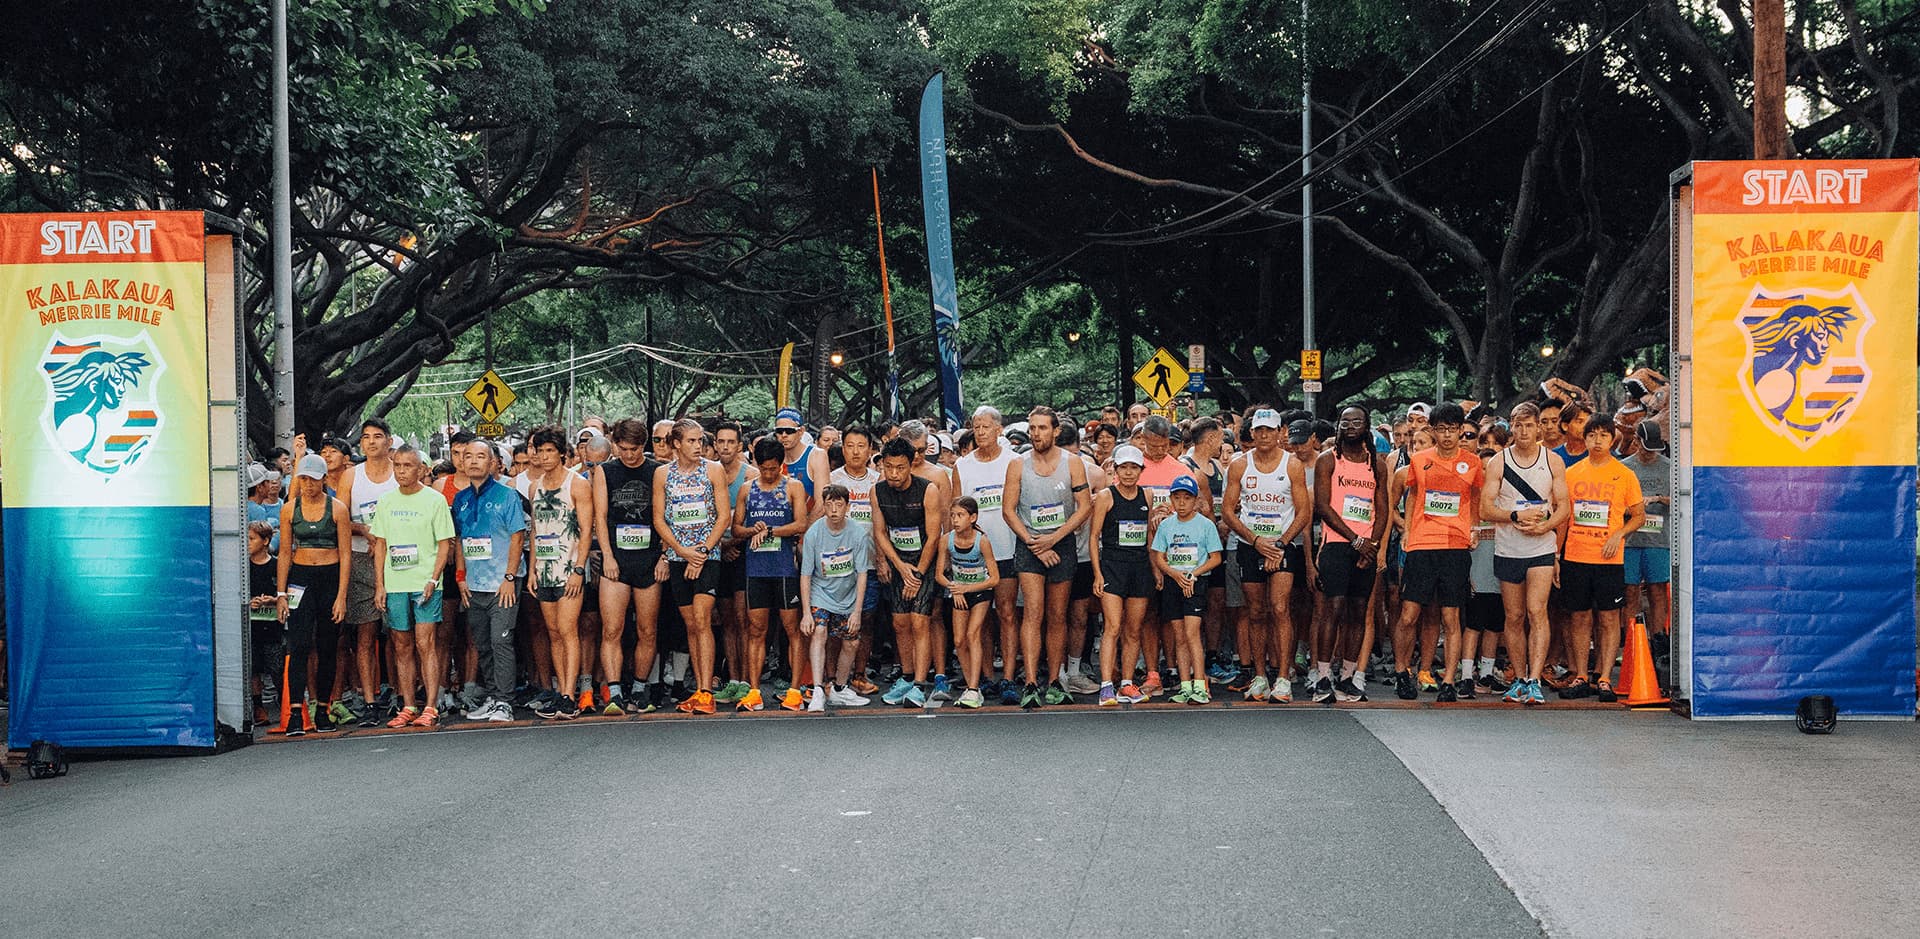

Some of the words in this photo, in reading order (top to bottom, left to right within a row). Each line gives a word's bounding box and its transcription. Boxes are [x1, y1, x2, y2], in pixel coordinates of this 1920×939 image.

[1742, 169, 1869, 205] START
[40, 219, 156, 256] START
[1726, 230, 1884, 263] KALAKAUA
[1739, 255, 1816, 279] MERRIE
[1822, 257, 1871, 279] MILE
[26, 278, 175, 311] KALAKAUA
[39, 303, 111, 326] MERRIE
[117, 306, 162, 326] MILE
[479, 425, 501, 435] AHEAD
[979, 495, 1001, 504] 50119
[1245, 493, 1286, 504] POLSKA
[1430, 501, 1453, 509] 60072
[1037, 514, 1058, 523] 60087
[1579, 510, 1601, 519] 60075
[1253, 523, 1275, 531] 50267
[622, 535, 643, 543] 50251
[894, 537, 914, 545] 50420
